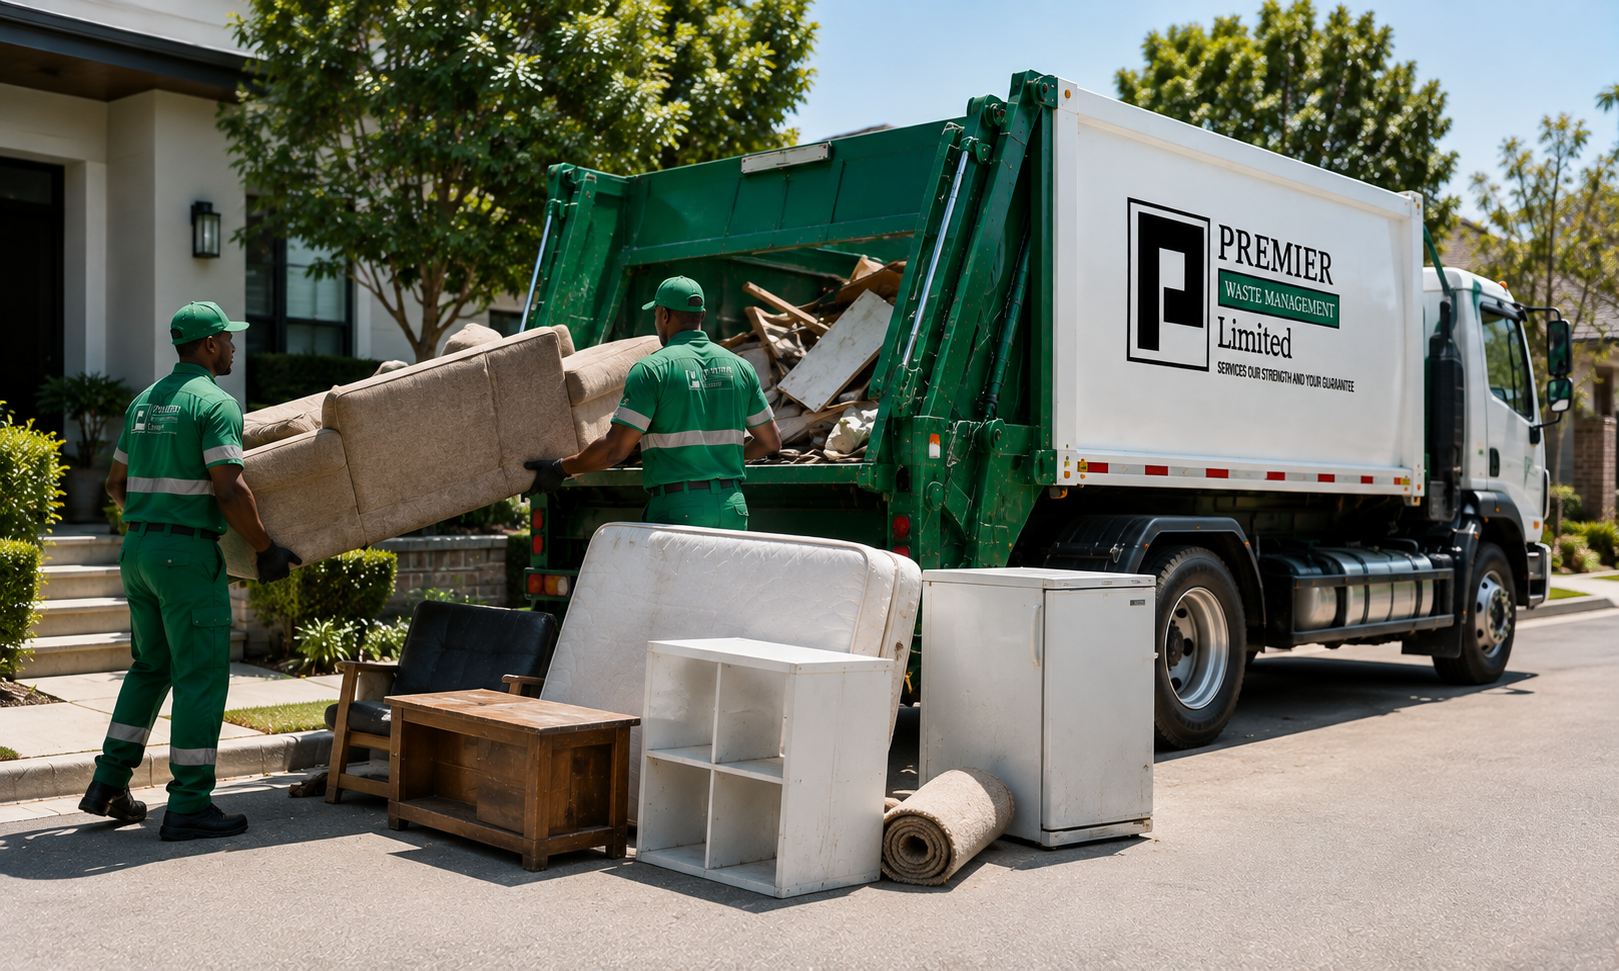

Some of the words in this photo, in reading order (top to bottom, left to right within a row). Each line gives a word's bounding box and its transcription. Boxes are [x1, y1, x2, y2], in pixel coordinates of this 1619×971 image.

[1218, 224, 1334, 285] PREMIER
[1225, 280, 1262, 303] WASTE
[1265, 290, 1335, 318] MANAGEMENT
[1217, 316, 1292, 359] Limited
[1217, 361, 1247, 378] SERVICES
[1247, 366, 1261, 379] OUR
[1261, 367, 1292, 384] STRENGTH
[1292, 372, 1305, 385] AND
[1305, 374, 1322, 388] YOUR
